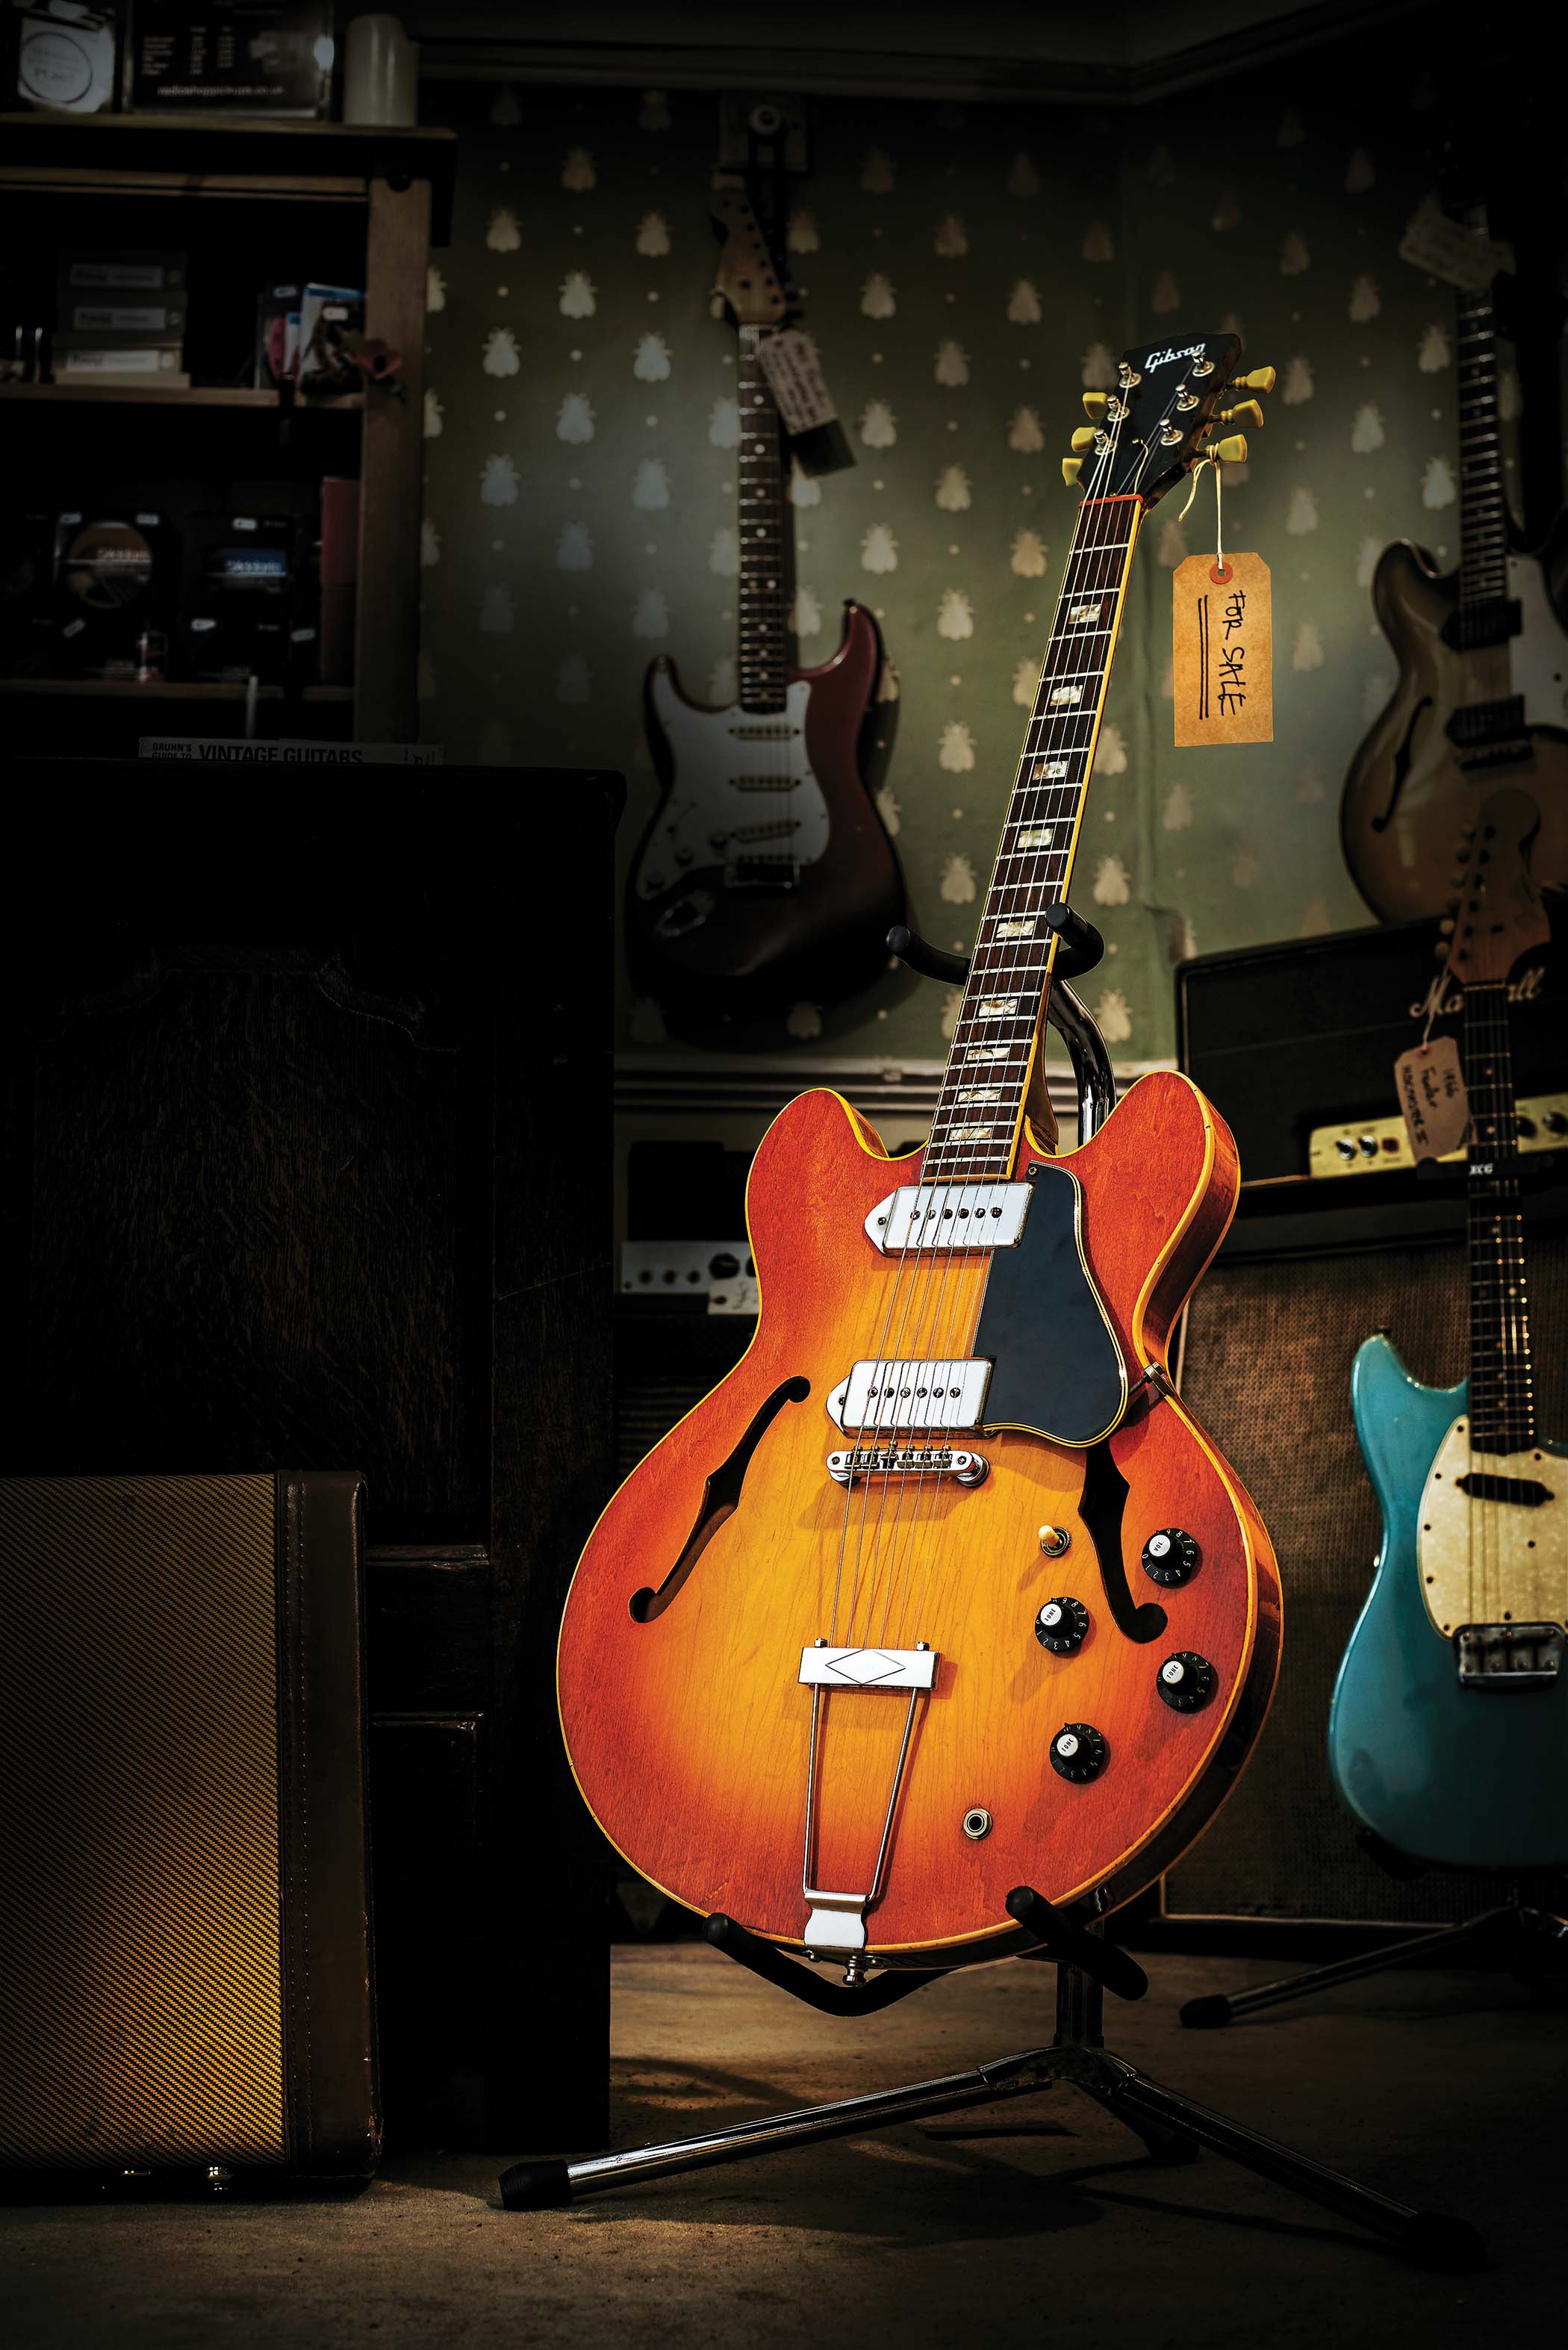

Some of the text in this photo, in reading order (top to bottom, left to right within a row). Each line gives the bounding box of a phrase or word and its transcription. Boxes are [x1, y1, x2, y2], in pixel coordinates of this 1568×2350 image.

[1144, 343, 1207, 373] Gibson
[1218, 590, 1246, 716] FOR SALE
[152, 742, 192, 752] GRUHN'S
[199, 745, 362, 764] VINTAGE GUITARS
[1153, 1570, 1159, 1579] 2
[1165, 1572, 1169, 1581] 3
[1044, 1608, 1057, 1622] TONE
[1042, 1638, 1049, 1646] 2
[1054, 1641, 1058, 1650] 3
[1166, 1664, 1179, 1679] TONE
[1062, 1738, 1074, 1752] TONE
